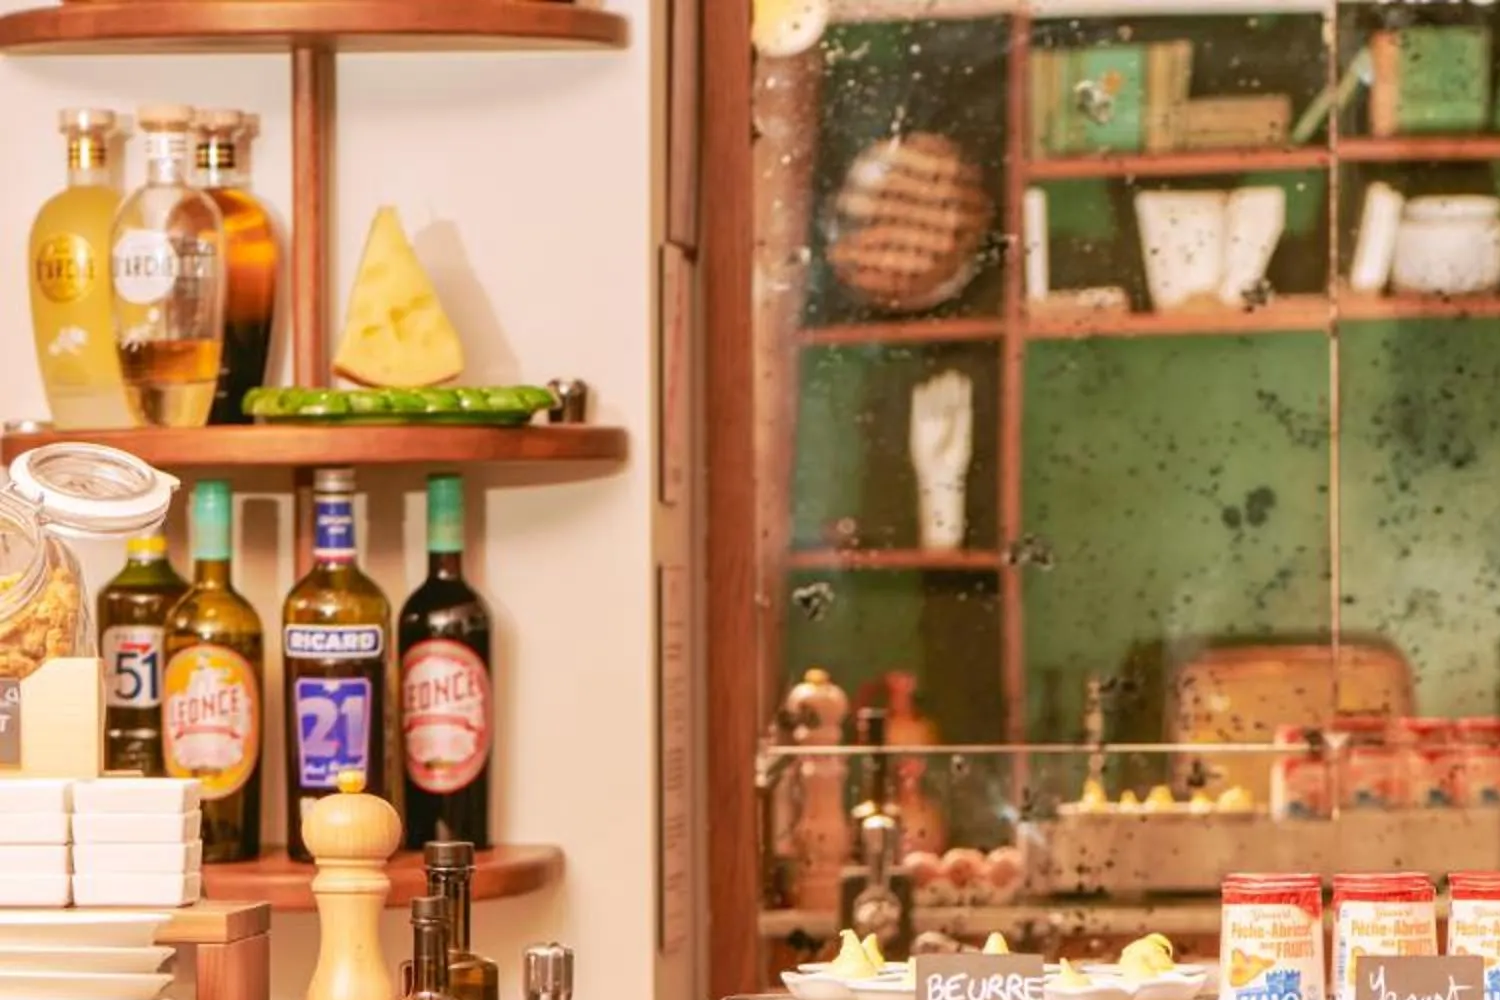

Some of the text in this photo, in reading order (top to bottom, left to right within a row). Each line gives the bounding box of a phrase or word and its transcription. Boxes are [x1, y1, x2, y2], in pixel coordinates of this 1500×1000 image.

[289, 632, 376, 650] RICARD
[114, 652, 159, 700] 51
[297, 696, 366, 757] 21
